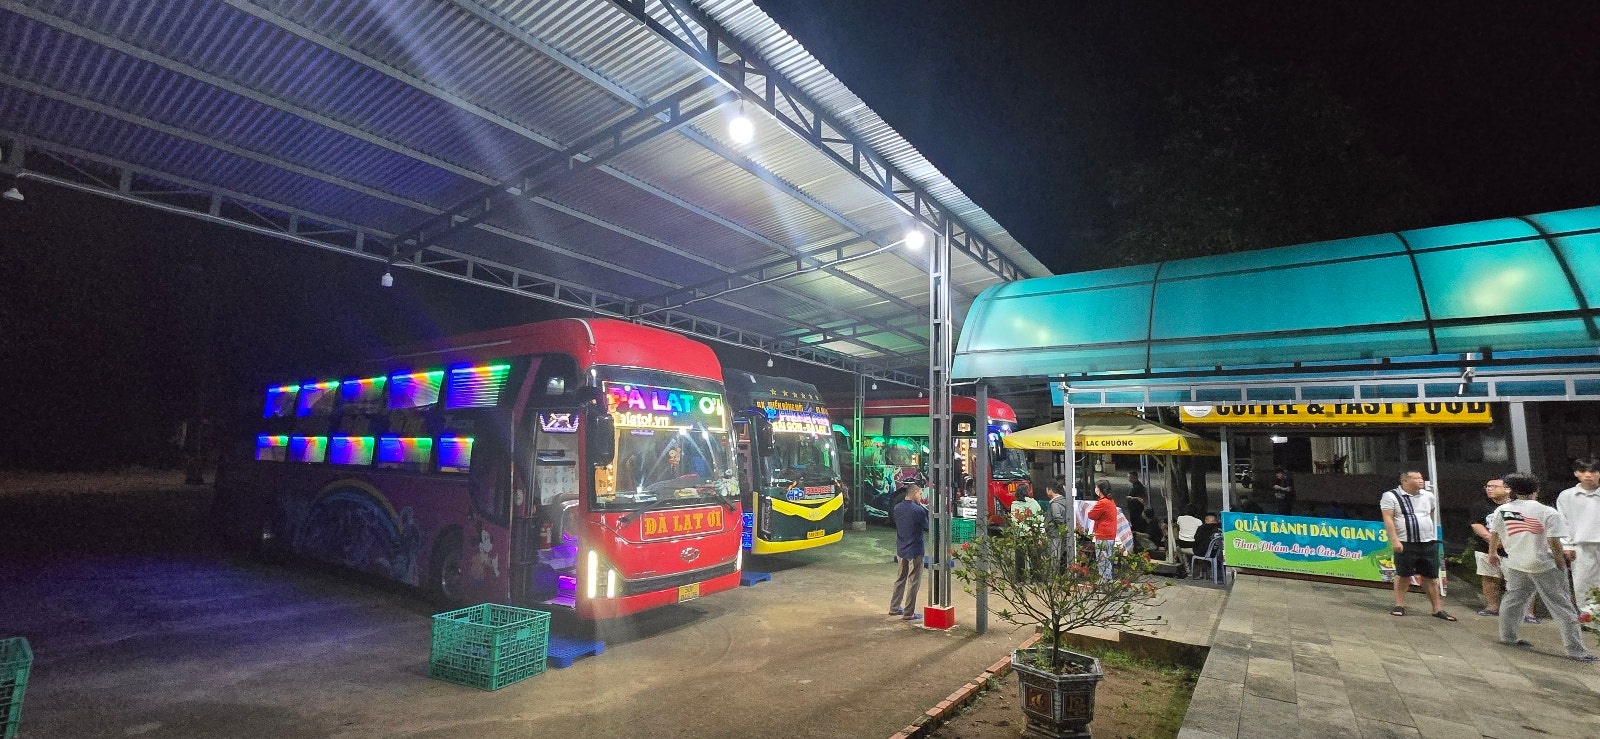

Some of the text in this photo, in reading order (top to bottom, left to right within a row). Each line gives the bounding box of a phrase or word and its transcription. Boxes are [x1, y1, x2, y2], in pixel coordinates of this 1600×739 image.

[652, 391, 693, 416] LẠT
[644, 509, 721, 536] ĐÀ LẠT ƠI
[1270, 519, 1308, 536] BÁNH
[1309, 521, 1339, 538] DÂN
[1341, 526, 1376, 541] GIAN
